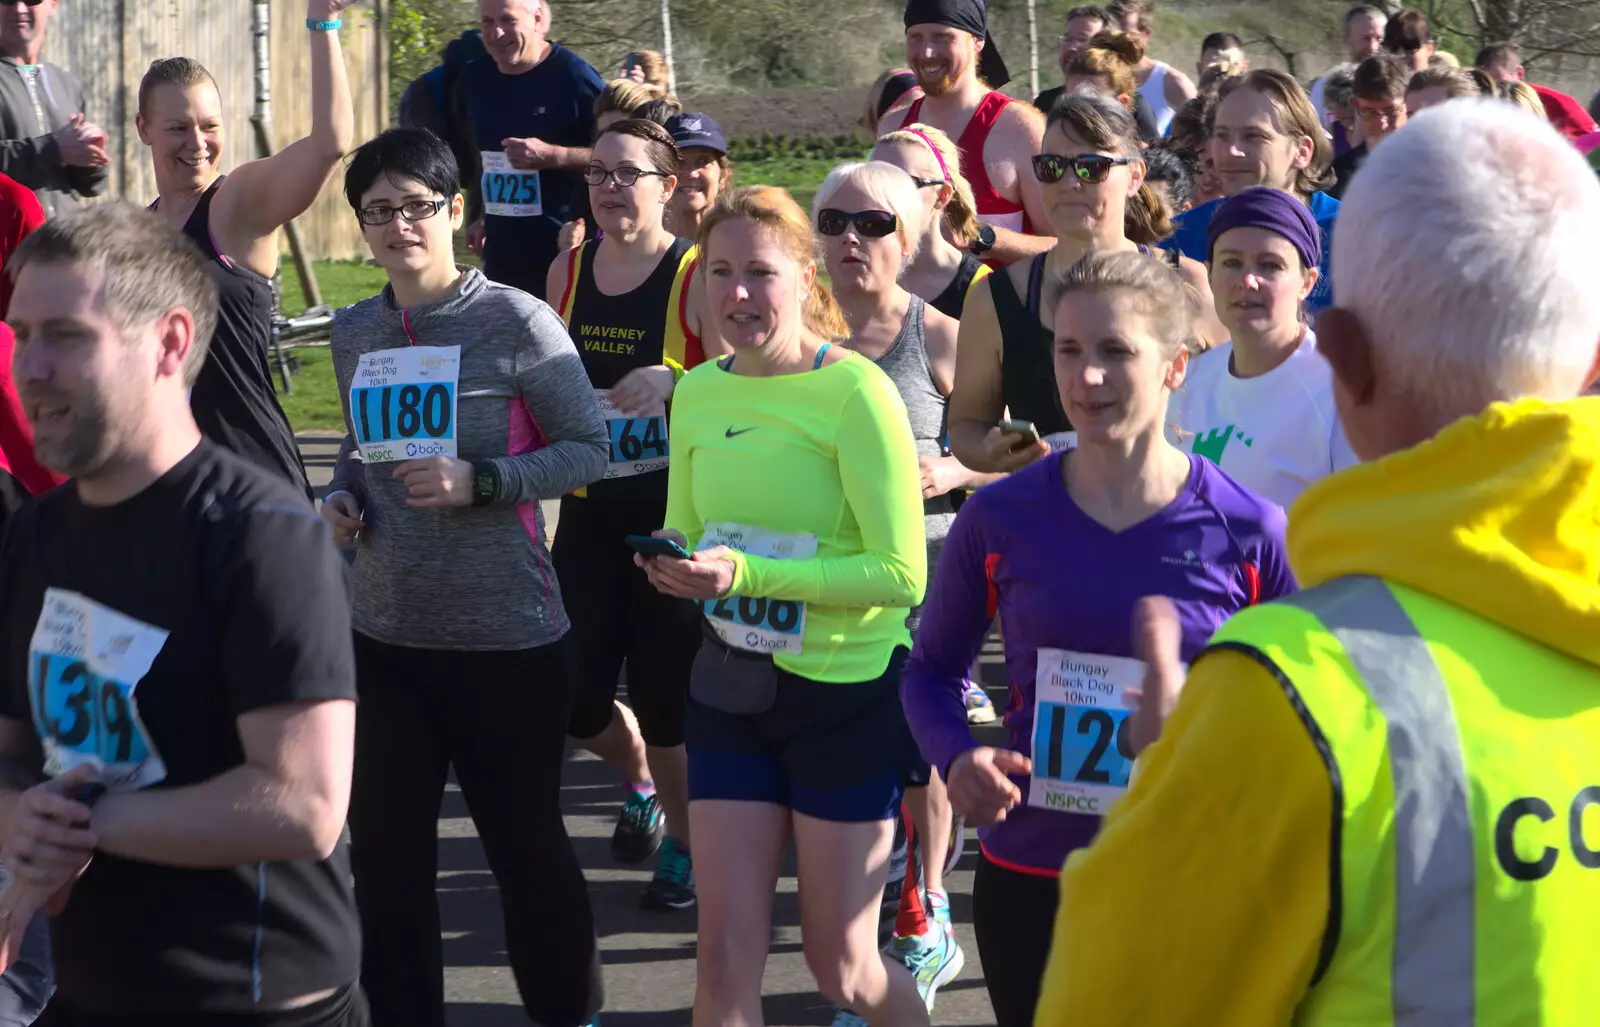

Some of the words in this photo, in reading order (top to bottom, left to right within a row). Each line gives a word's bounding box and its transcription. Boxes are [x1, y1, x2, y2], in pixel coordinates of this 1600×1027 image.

[485, 174, 537, 204] 1225
[580, 324, 646, 341] WAVENEY
[584, 340, 634, 355] VALLEY
[369, 356, 395, 367] Bungay
[361, 368, 380, 378] Black
[382, 366, 397, 376] Dog
[369, 378, 388, 387] 10km
[359, 384, 451, 442] 1180
[367, 449, 393, 461] NSPCC
[1061, 658, 1109, 678] Bungay
[1051, 673, 1083, 690] Black
[1088, 678, 1114, 695] Dog
[1063, 690, 1097, 705] 10km
[1045, 791, 1099, 811] NSPCC
